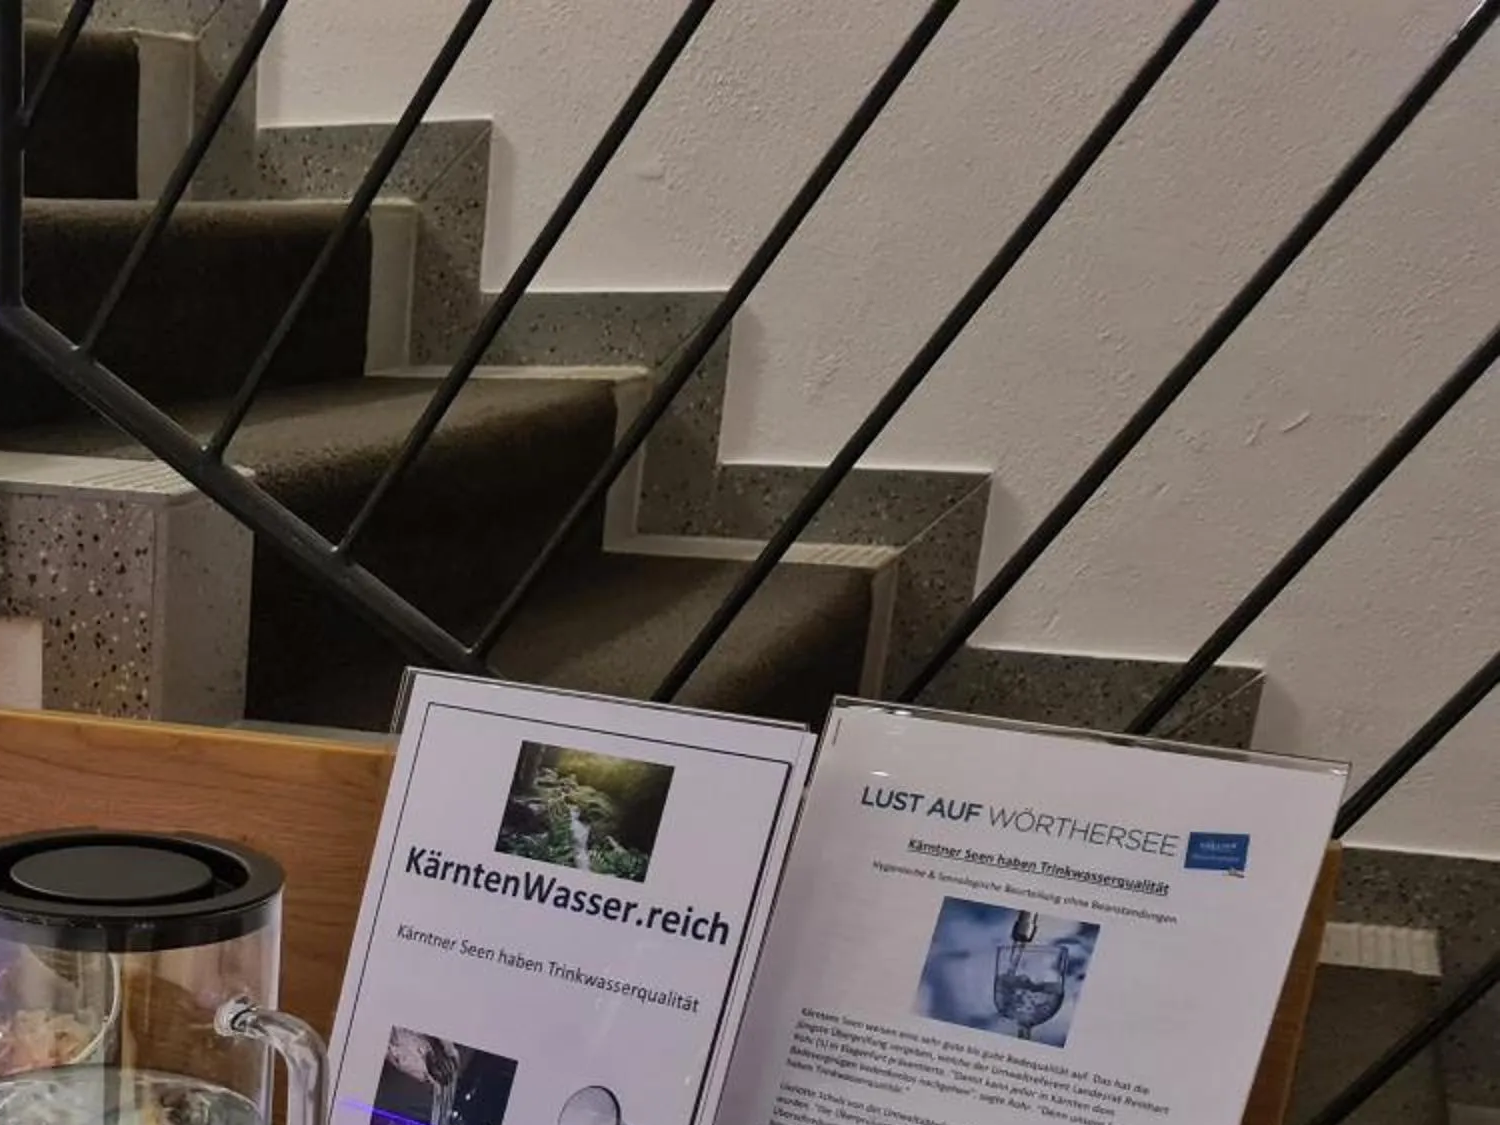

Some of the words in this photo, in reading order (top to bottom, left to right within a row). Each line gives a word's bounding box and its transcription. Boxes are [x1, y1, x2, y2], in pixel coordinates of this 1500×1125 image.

[859, 785, 925, 814] LUST
[926, 796, 984, 824] AUF
[984, 805, 1181, 857] WÖRTHERSEE
[404, 844, 734, 946] KärntenWasser.reich
[907, 837, 962, 856] Kärntner
[963, 847, 995, 862] Seen
[996, 852, 1037, 870] haben
[1039, 860, 1171, 893] Trinkwasserqualität
[396, 922, 456, 952] Kärntner
[458, 938, 495, 961] Seen
[496, 947, 544, 974] haben
[546, 960, 701, 1013] Trinkwasserqualität
